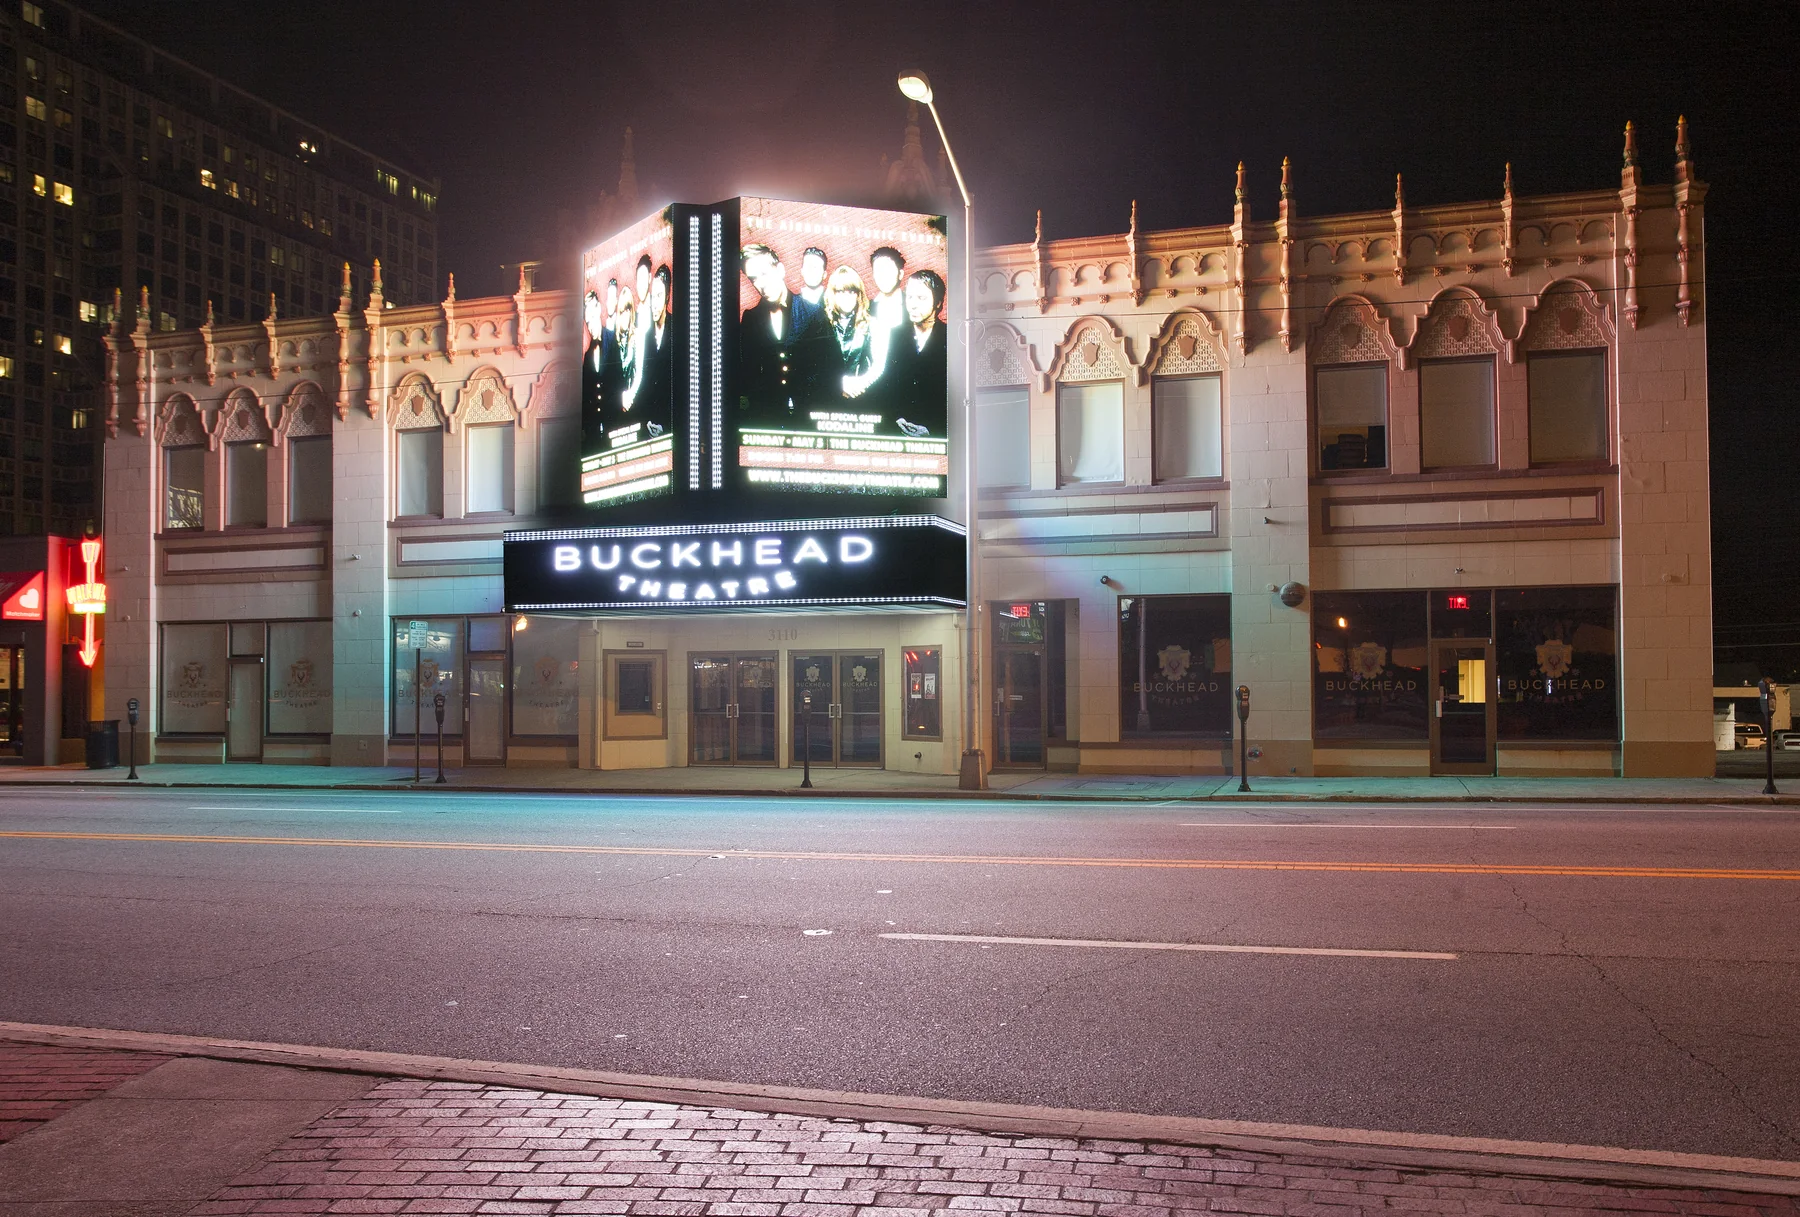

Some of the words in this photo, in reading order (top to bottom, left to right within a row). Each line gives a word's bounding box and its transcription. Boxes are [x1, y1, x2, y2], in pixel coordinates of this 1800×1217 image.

[747, 216, 772, 230] THE
[779, 219, 848, 237] AIRBORNE
[856, 227, 894, 241] TOXIC
[901, 231, 941, 246] EVENT
[743, 434, 785, 446] SUNDAY
[792, 437, 814, 448] MAY
[830, 438, 849, 450] THE
[554, 536, 875, 572] BUCKHEAD
[617, 570, 797, 600] THEATRE
[768, 629, 797, 641] 3110
[1133, 682, 1218, 692] BUCKHEAD
[1326, 680, 1416, 691] BUCKHEAD
[167, 690, 223, 698] BUCKHEAD
[274, 689, 332, 698] BUCKHEAD
